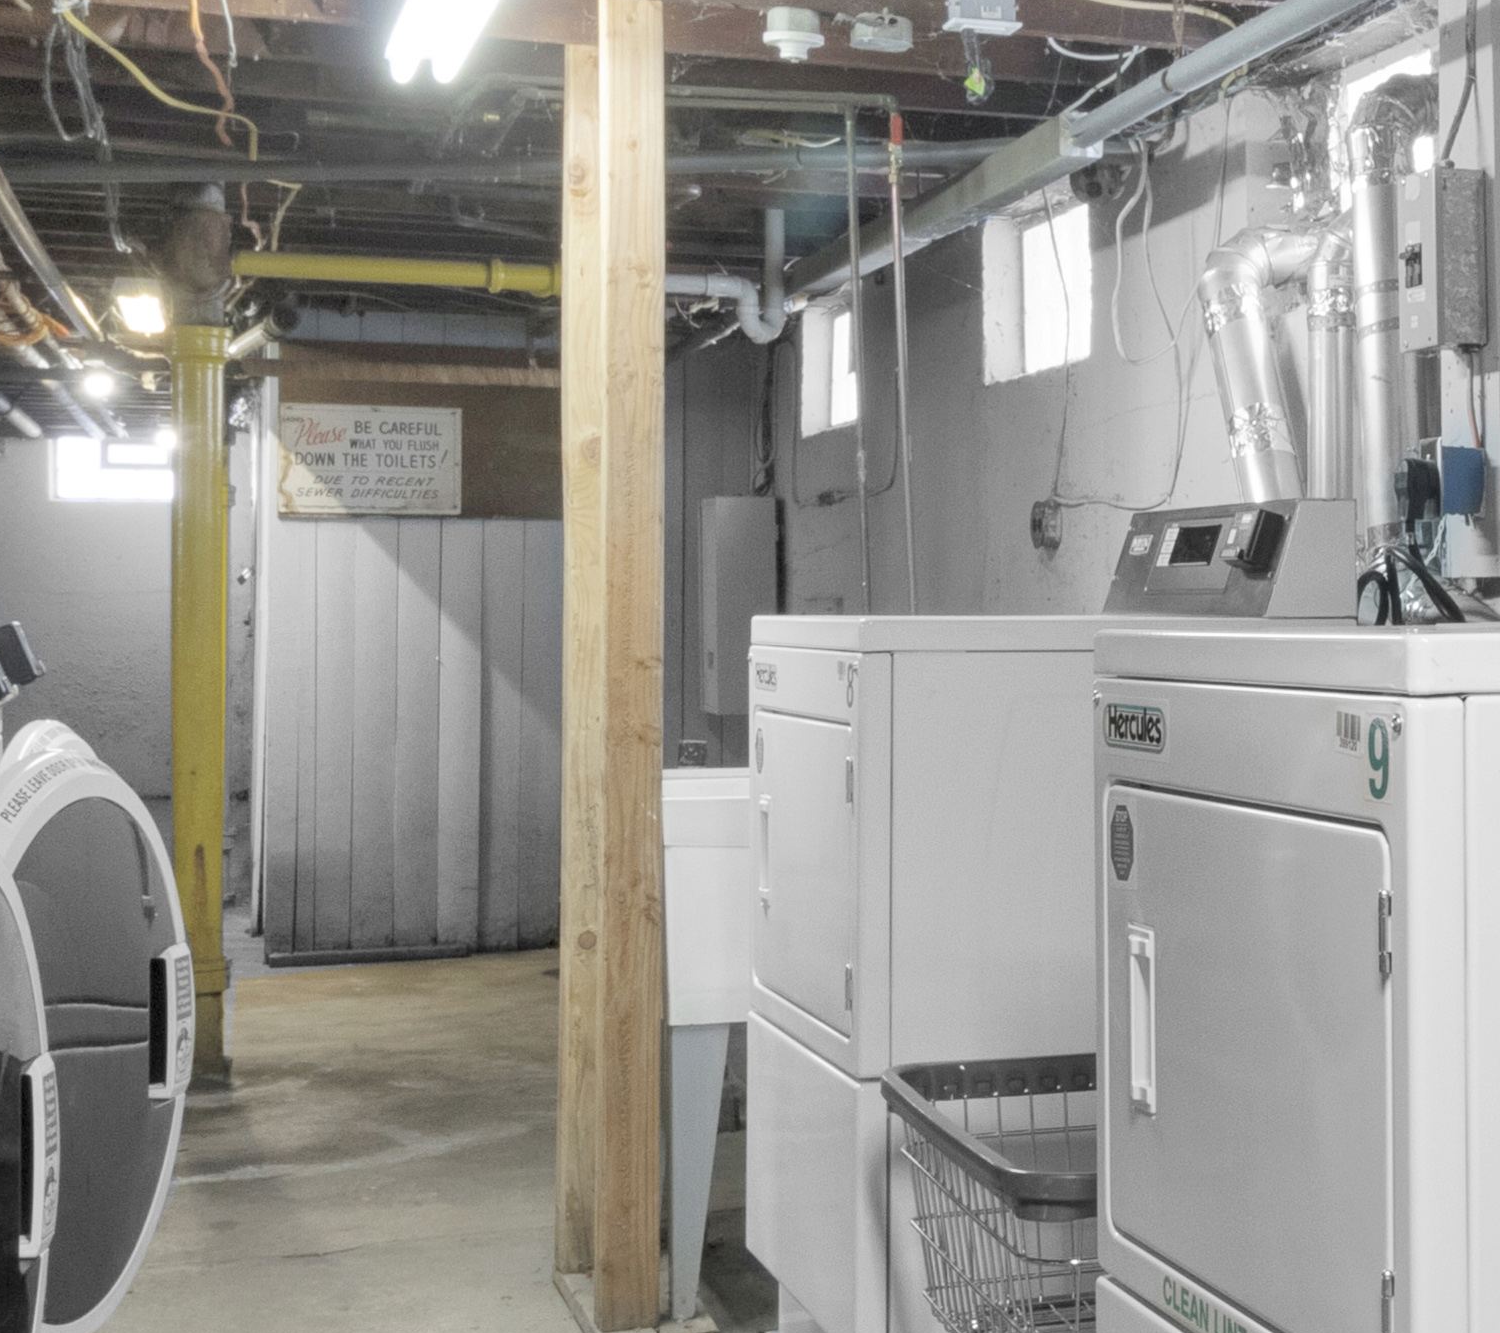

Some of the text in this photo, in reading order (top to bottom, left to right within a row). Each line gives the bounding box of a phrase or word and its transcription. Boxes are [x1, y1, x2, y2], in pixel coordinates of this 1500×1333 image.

[294, 417, 347, 447] Please
[354, 421, 443, 436] BE CAREFUL
[349, 439, 440, 452] WHAT YOU FLUSH
[294, 452, 336, 467] DOWN
[342, 453, 368, 467] THE
[314, 475, 435, 487] DUE TO RECENT
[295, 487, 440, 499] SEWER DIFFICULTIES
[1107, 704, 1162, 744] Hercules
[1368, 717, 1389, 800] 9
[0, 787, 32, 824] PLEASE
[25, 770, 52, 794] LEAVE
[1163, 1275, 1209, 1332] CLEAN
